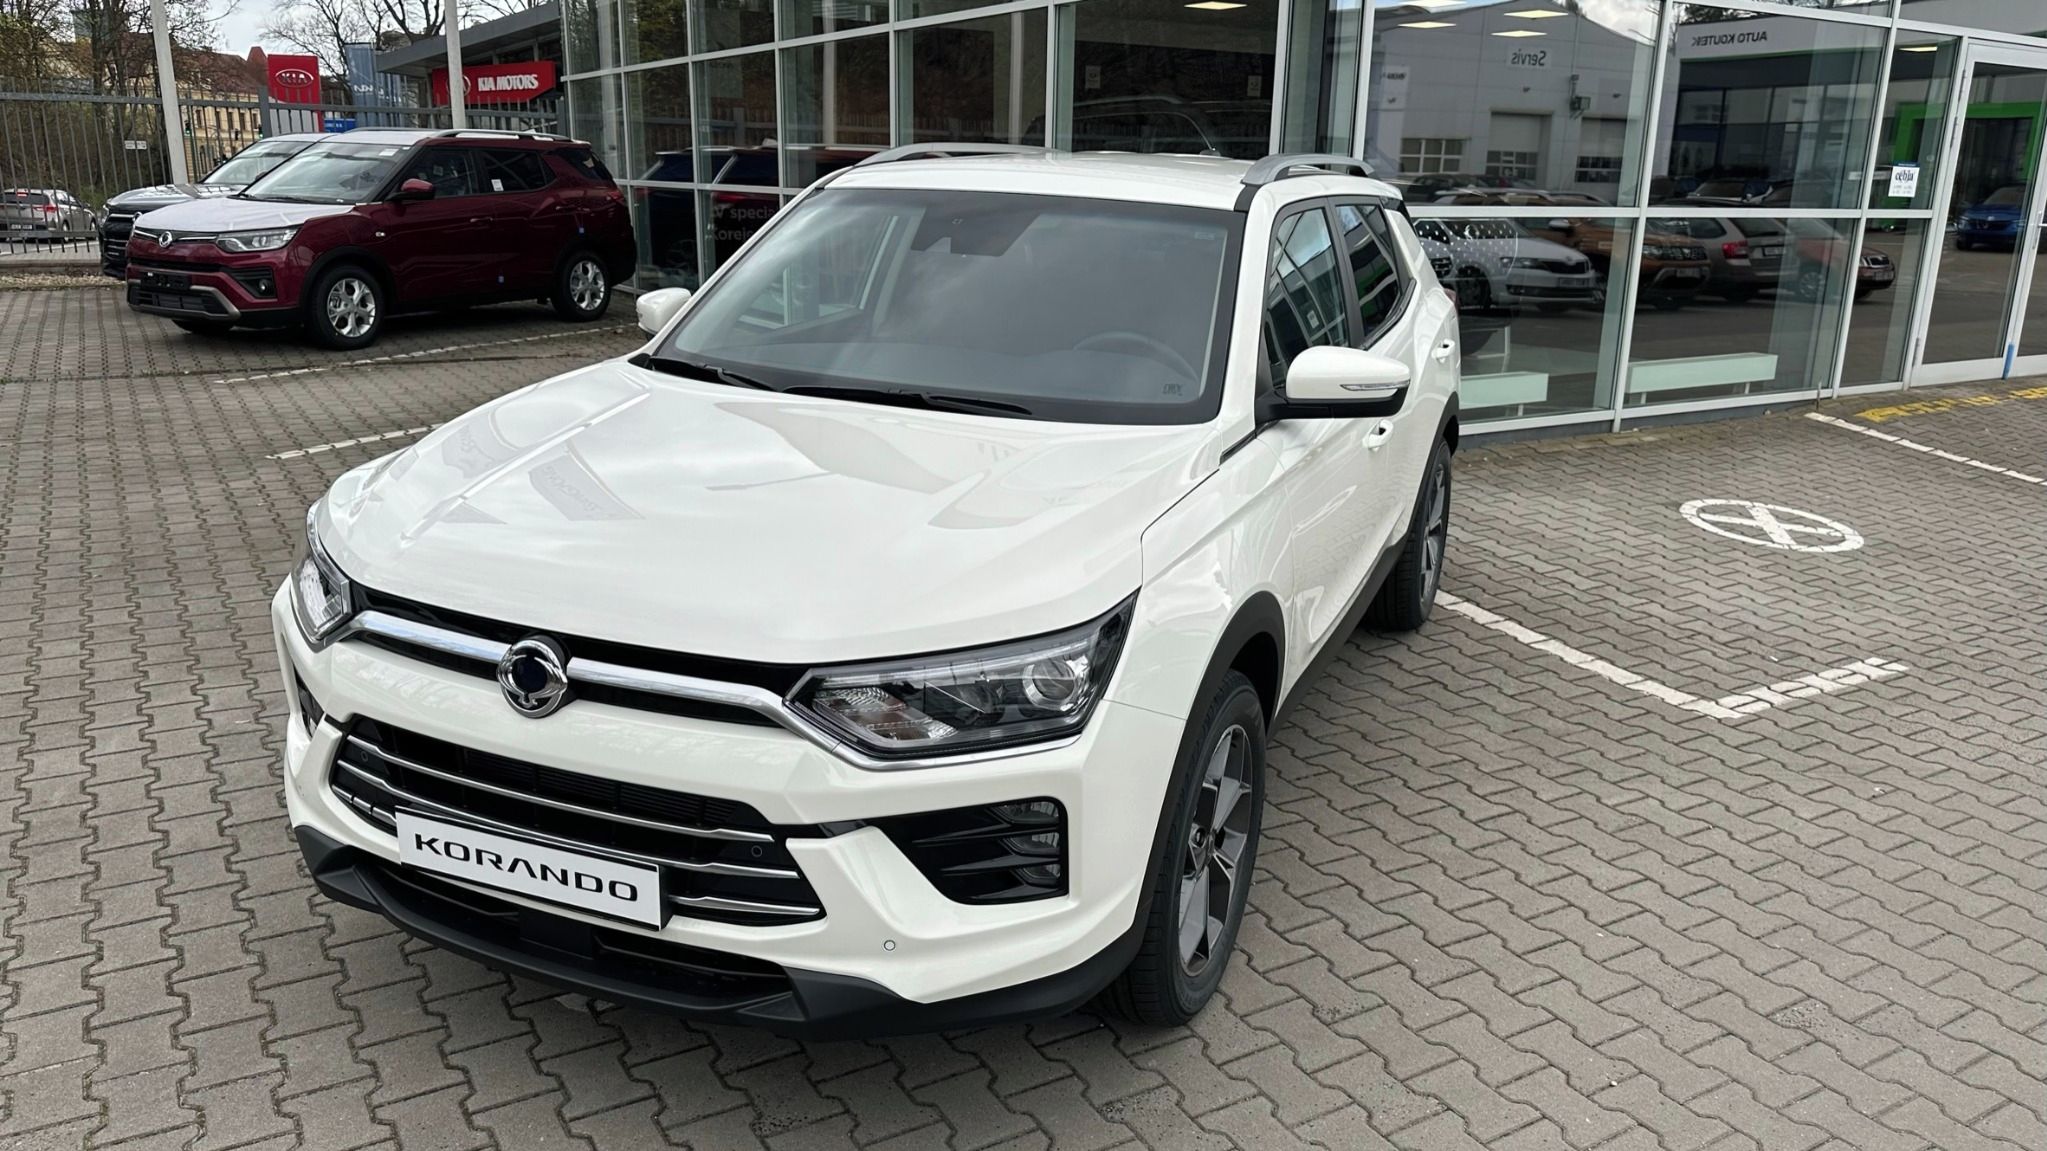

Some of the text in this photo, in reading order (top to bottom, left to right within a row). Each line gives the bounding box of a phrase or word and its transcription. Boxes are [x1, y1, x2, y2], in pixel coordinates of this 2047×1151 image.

[477, 74, 539, 91] KIA MOTORS
[414, 833, 638, 902] KORANDO
